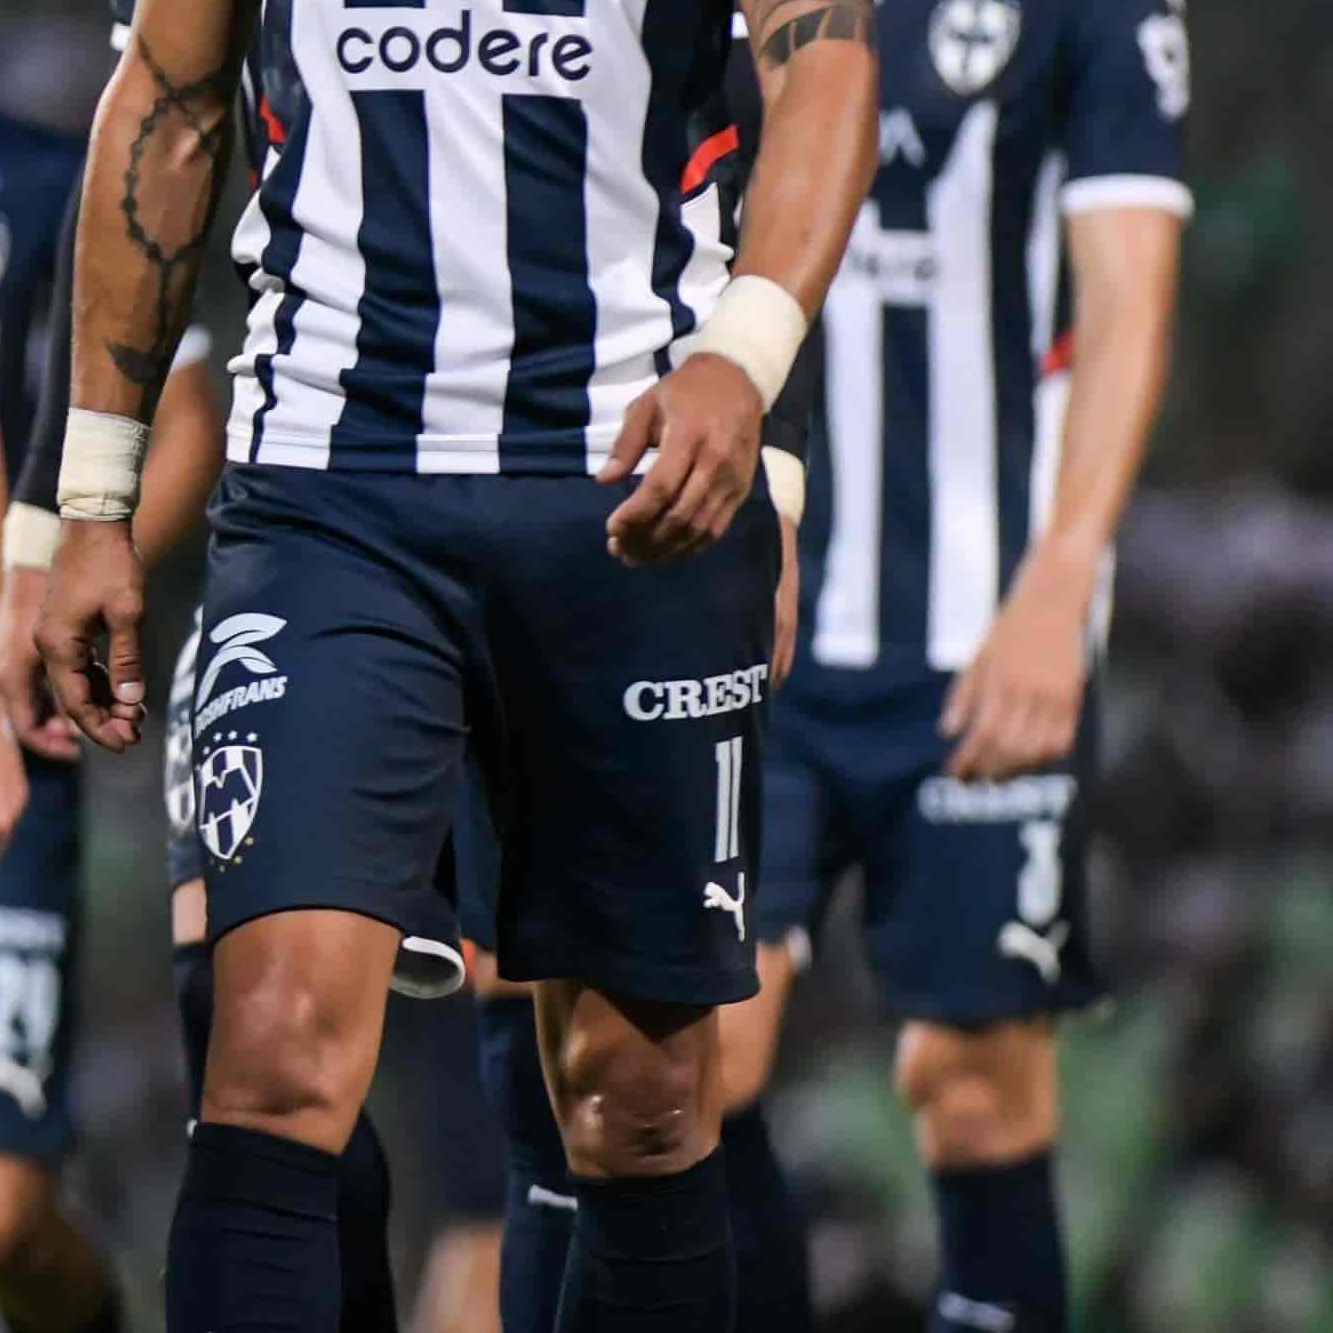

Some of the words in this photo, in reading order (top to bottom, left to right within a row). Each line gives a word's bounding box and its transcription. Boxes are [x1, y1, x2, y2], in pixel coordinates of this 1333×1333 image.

[335, 9, 594, 82] codere
[622, 664, 769, 721] CREST
[713, 735, 743, 864] 11
